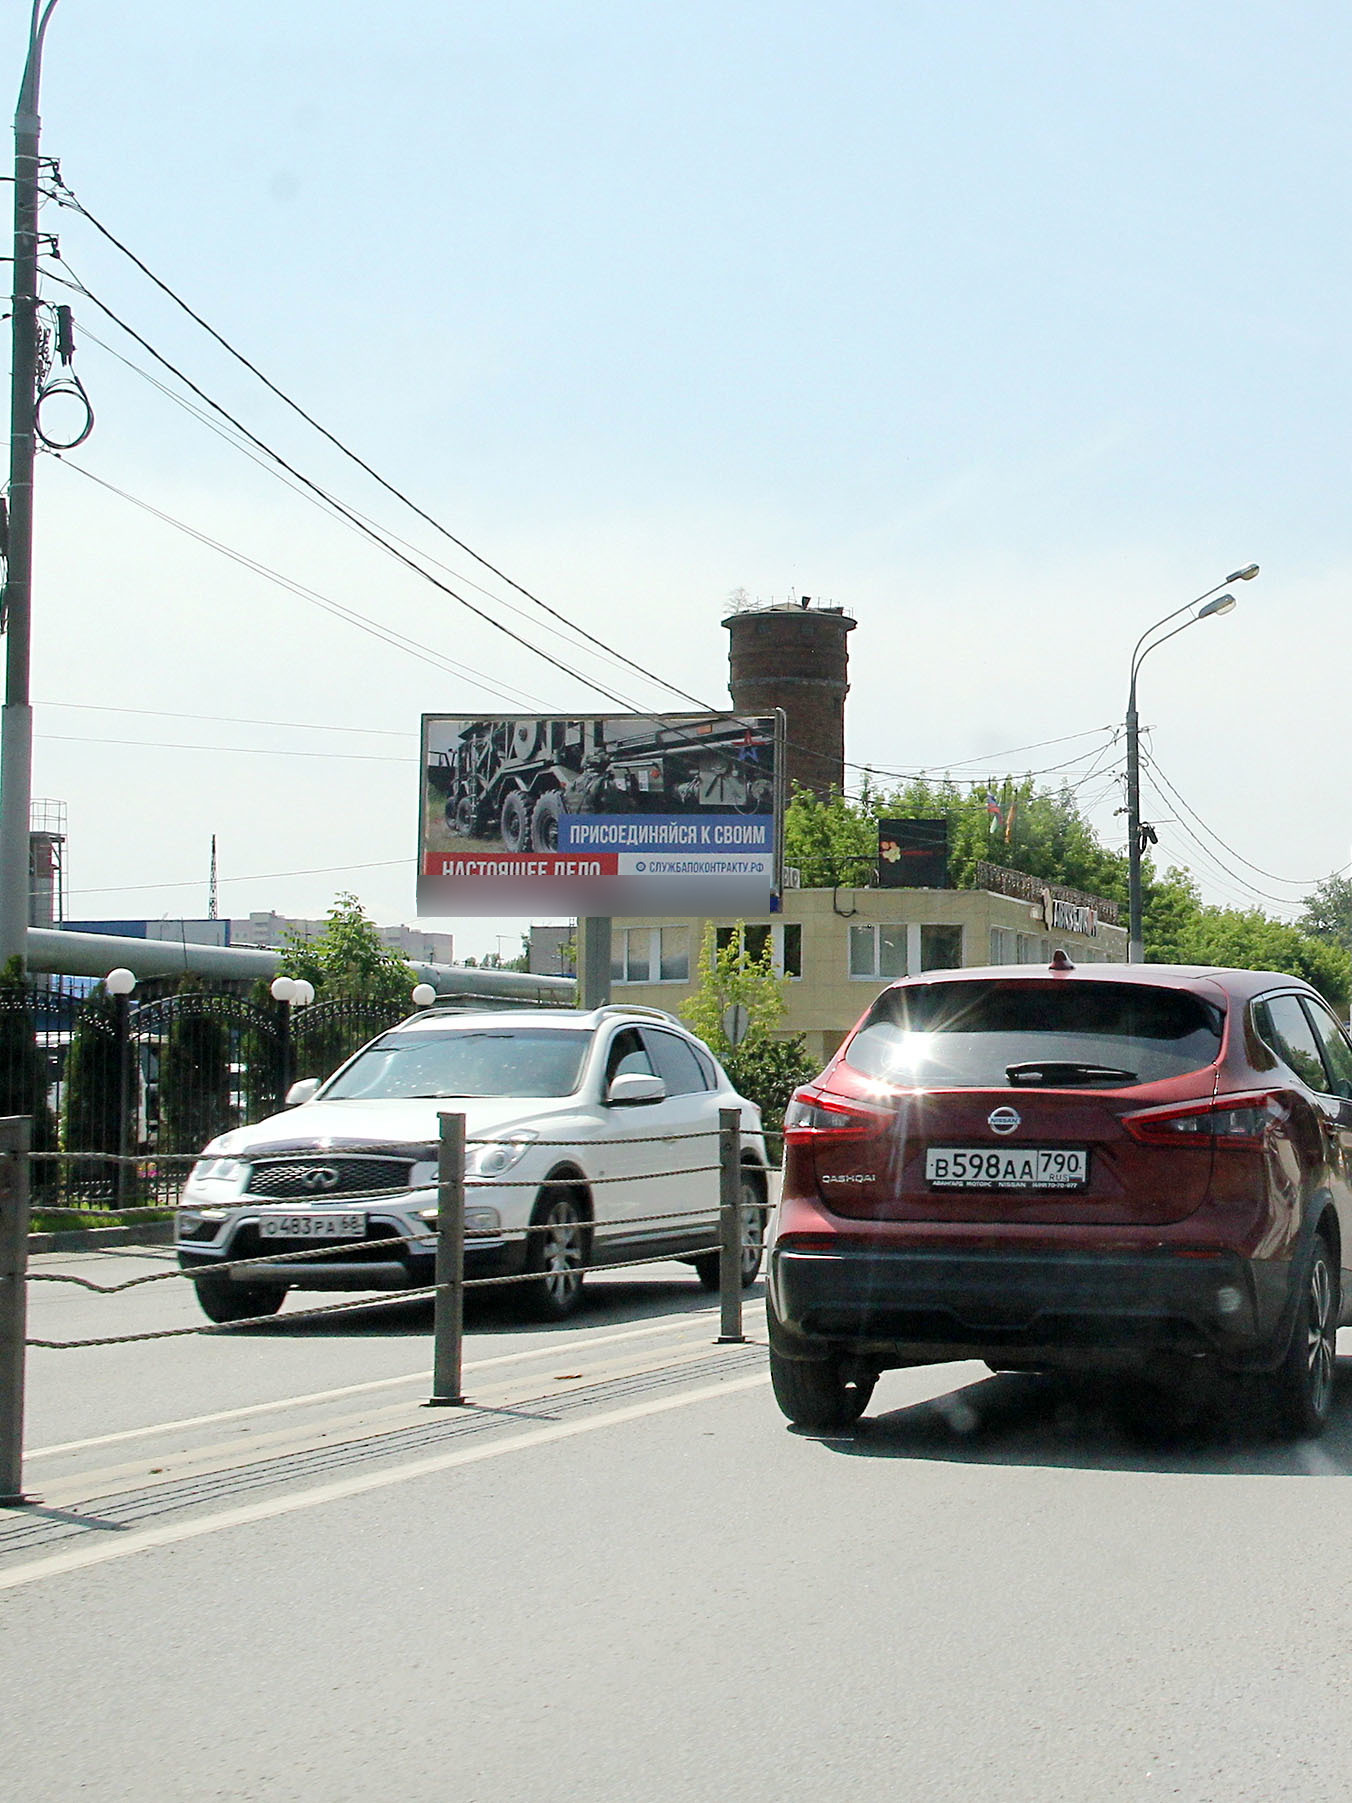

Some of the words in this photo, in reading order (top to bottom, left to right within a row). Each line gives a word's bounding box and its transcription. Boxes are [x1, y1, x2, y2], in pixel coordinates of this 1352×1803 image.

[570, 822, 697, 845] ПРИСОЕДИНЯЙСЯ
[701, 825, 711, 844] К
[714, 825, 765, 844] СВОИМ
[649, 861, 764, 873] СЛУЖБАПОКОНТРАКТУ.РФ
[935, 1153, 1033, 1179] В598АА
[1041, 1153, 1079, 1173] 790
[822, 1174, 876, 1183] QASHQAI
